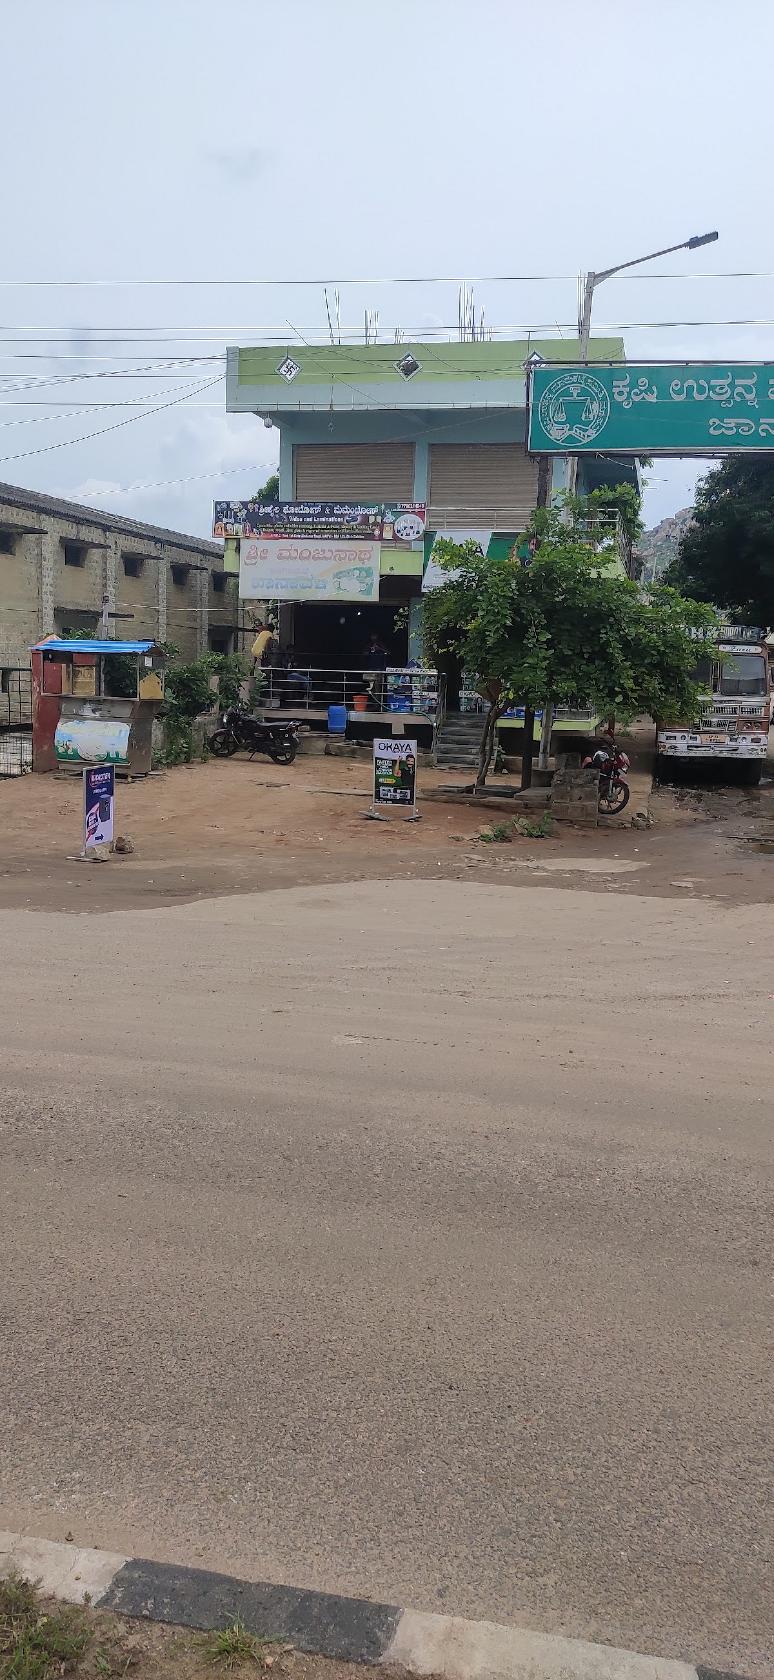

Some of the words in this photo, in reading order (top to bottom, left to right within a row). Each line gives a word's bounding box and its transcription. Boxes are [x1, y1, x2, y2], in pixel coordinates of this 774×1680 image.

[612, 373, 657, 408] ಕೃಷಿ
[670, 372, 759, 408] ಉತ್ಪನ್ನ
[244, 545, 268, 566] ಶ್ರೀ
[378, 742, 412, 752] OKAYA
